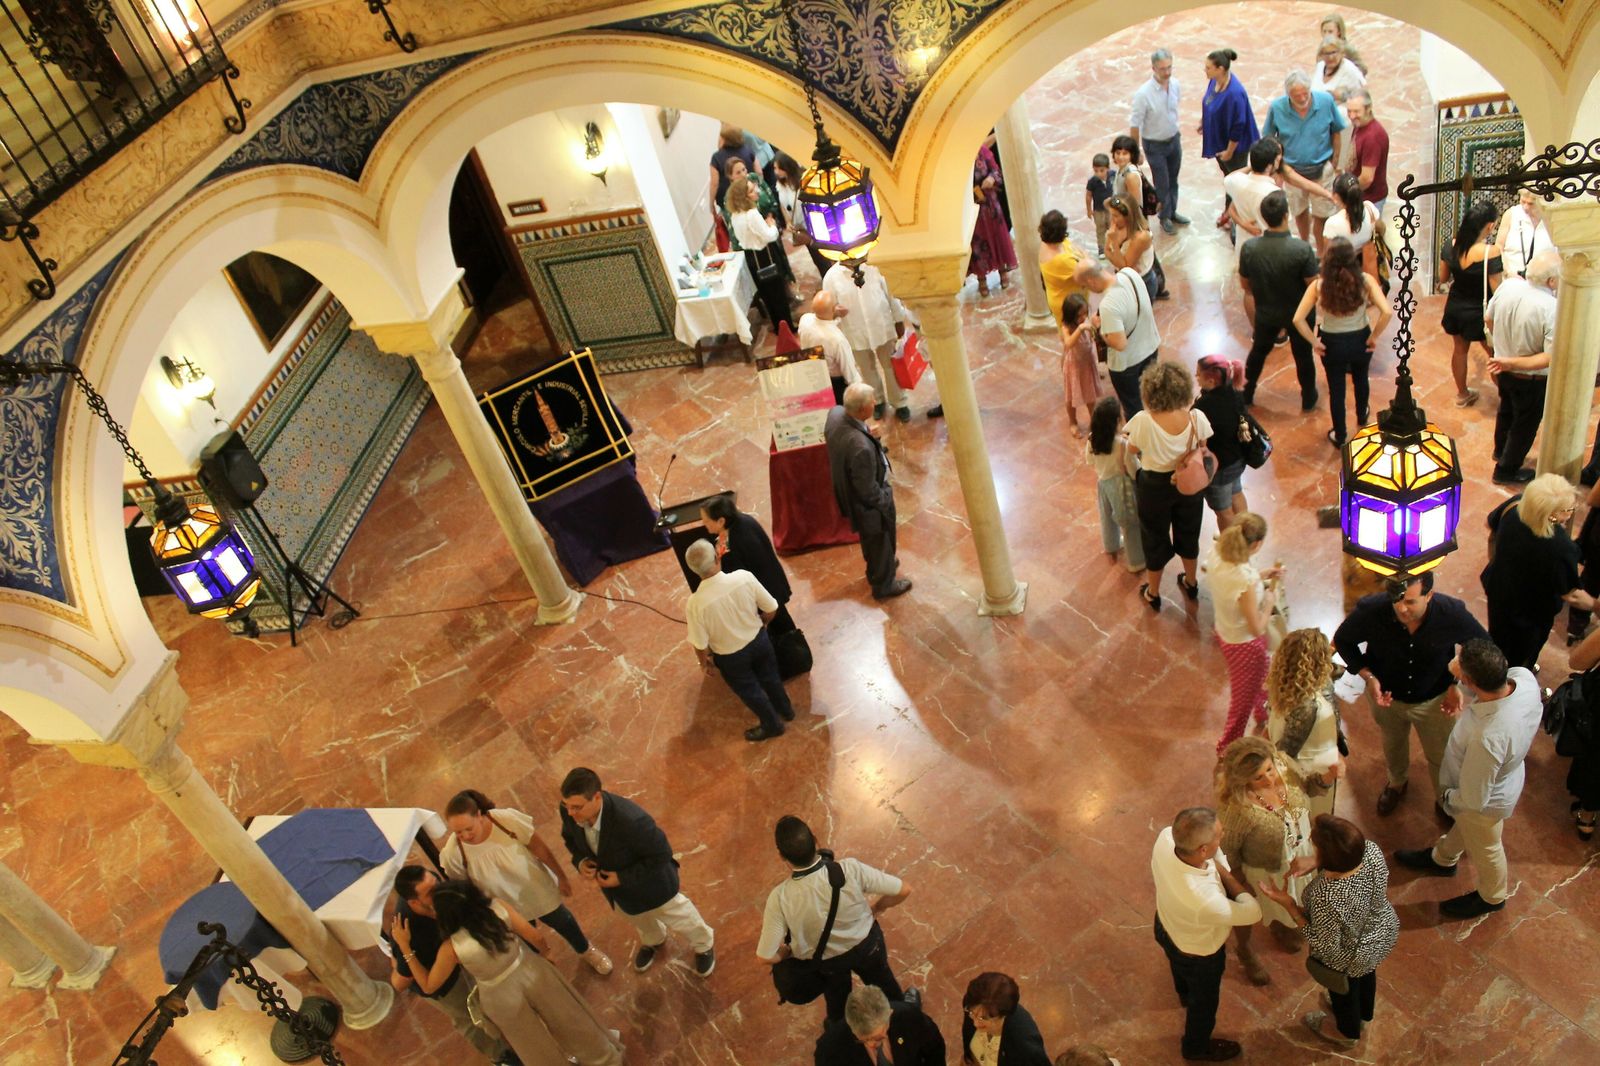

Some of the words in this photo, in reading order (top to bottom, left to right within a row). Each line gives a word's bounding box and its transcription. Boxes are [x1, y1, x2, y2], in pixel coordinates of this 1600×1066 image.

[512, 390, 532, 426] MERCANTIL
[544, 381, 581, 400] INDUSTRIAL
[578, 400, 588, 428] SEVILLA
